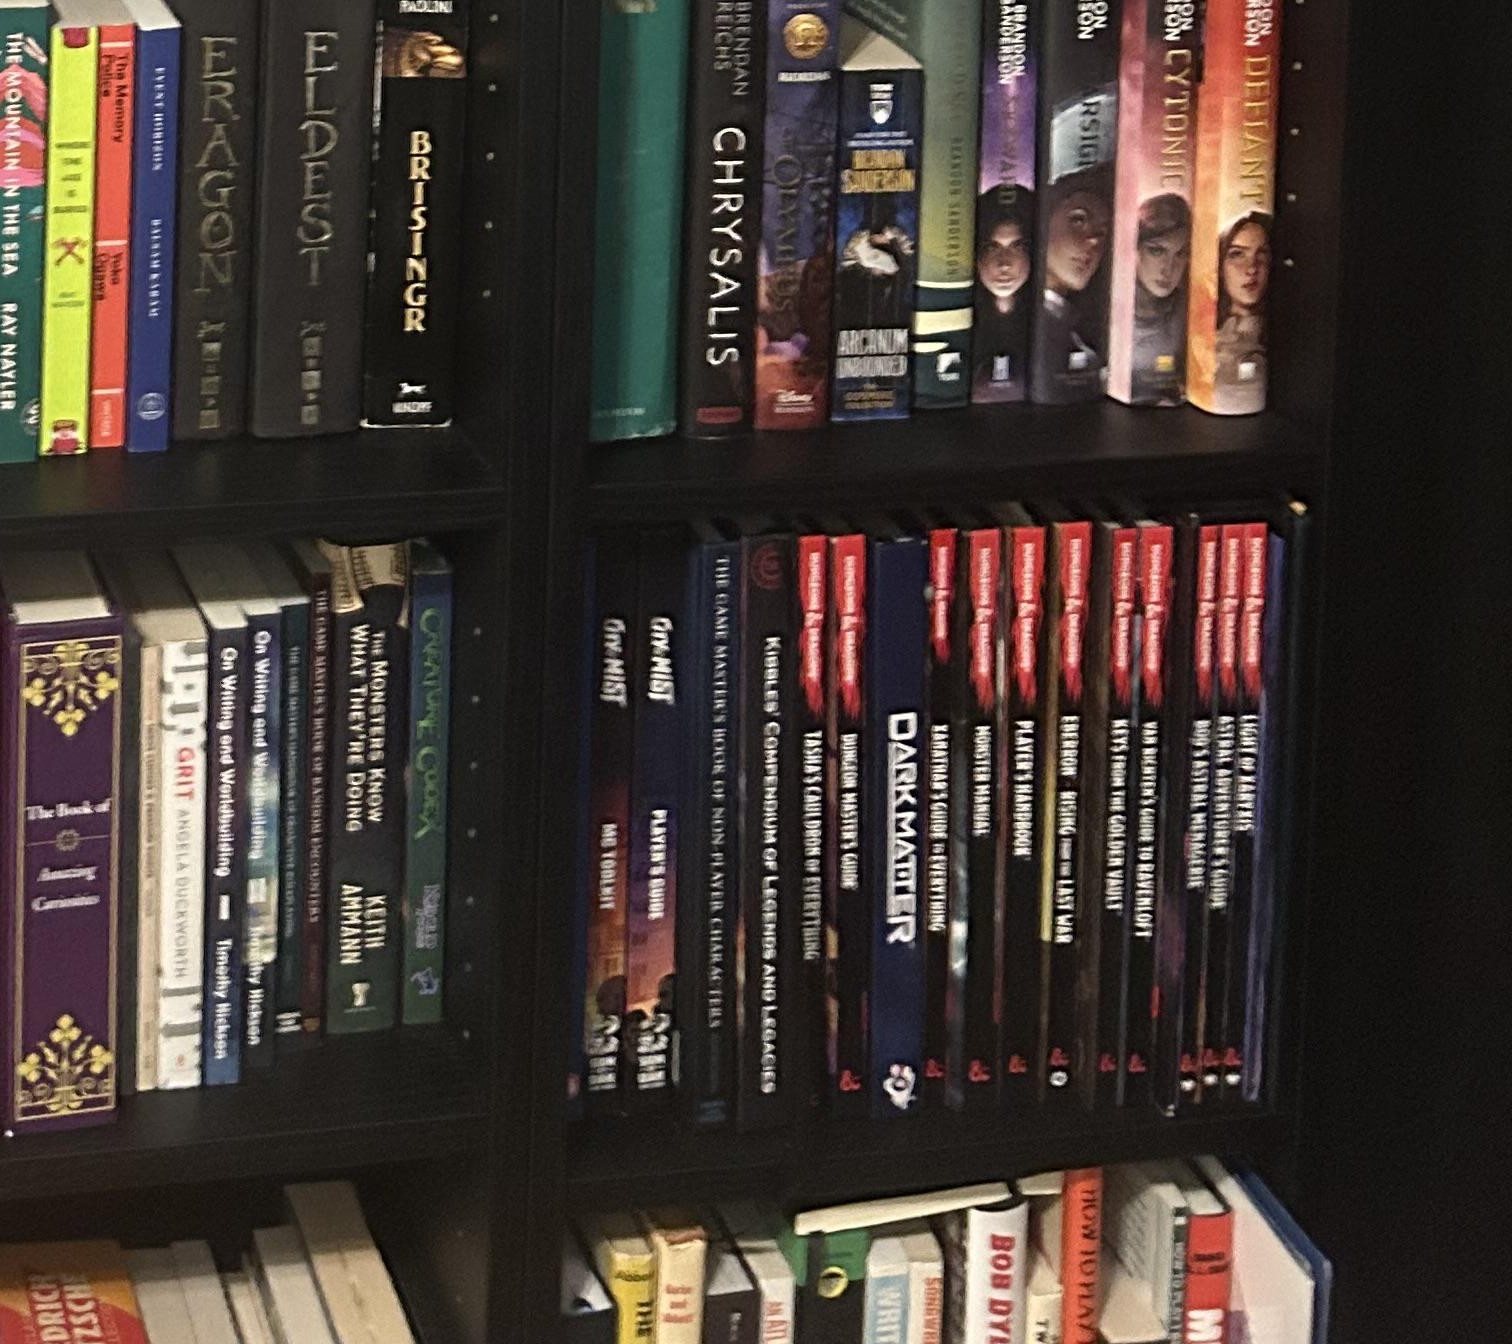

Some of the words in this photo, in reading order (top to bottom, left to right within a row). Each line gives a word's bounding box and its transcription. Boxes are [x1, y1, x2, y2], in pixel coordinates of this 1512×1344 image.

[6, 33, 22, 63] THE
[714, 2, 732, 70] REICHS
[733, 2, 751, 96] BRENDAN
[5, 73, 21, 170] MOUNTAIN
[4, 178, 20, 198] IN
[3, 205, 19, 237] THE
[706, 128, 746, 366] CHRYSALIS
[2, 243, 18, 275] SEA
[0, 303, 17, 336] RAY
[0, 344, 16, 410] NAYLER
[176, 747, 193, 801] GRIT
[973, 726, 991, 782] MONSTER
[1015, 721, 1033, 780] PLAYER'S
[973, 786, 990, 836] MANUAL
[1013, 784, 1031, 856] HANDBOOK
[339, 884, 362, 964] AMMANN
[364, 895, 386, 948] KEITH
[990, 1234, 1016, 1288] BOB
